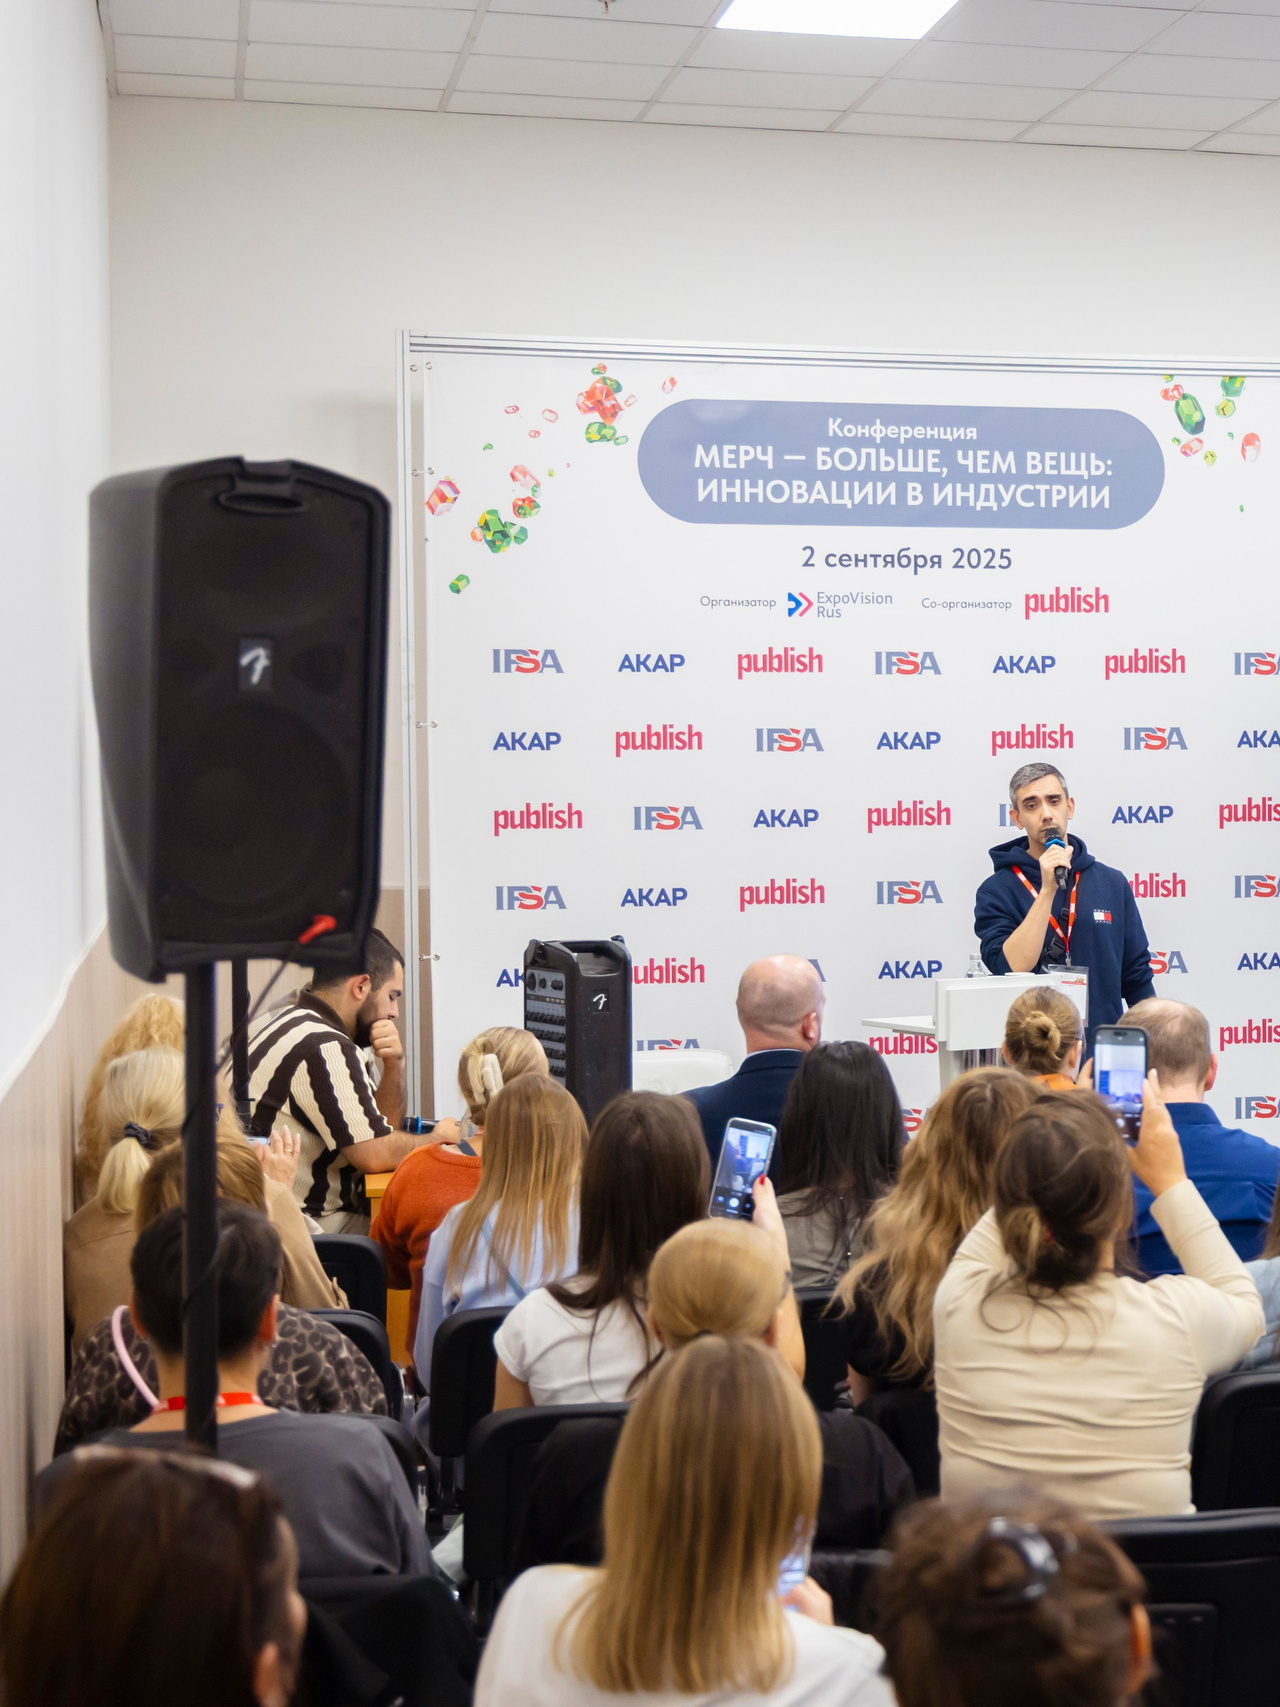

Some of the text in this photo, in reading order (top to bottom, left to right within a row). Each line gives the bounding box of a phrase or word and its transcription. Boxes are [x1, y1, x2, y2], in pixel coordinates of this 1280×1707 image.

[828, 417, 978, 444] Конференция
[695, 444, 1113, 482] МЕРЧ БОЛЬШЕ, ЧЕМ ВЕЩЬ:
[698, 478, 1111, 513] ИННОВАЦИИ В ИНДУСТРИИ
[802, 546, 1011, 575] 2 сентября 2025
[700, 596, 776, 609] Организатор
[817, 592, 893, 606] ExpoVision
[817, 607, 841, 618] Rus
[922, 587, 1109, 620] Со-организатор publish
[738, 647, 823, 680] publish
[1105, 648, 1185, 680] publish
[616, 724, 702, 757] publish
[992, 724, 1073, 756] publish
[494, 803, 582, 836] publish
[868, 800, 950, 833] publish
[740, 878, 824, 912] publish
[869, 1033, 938, 1055] publis
